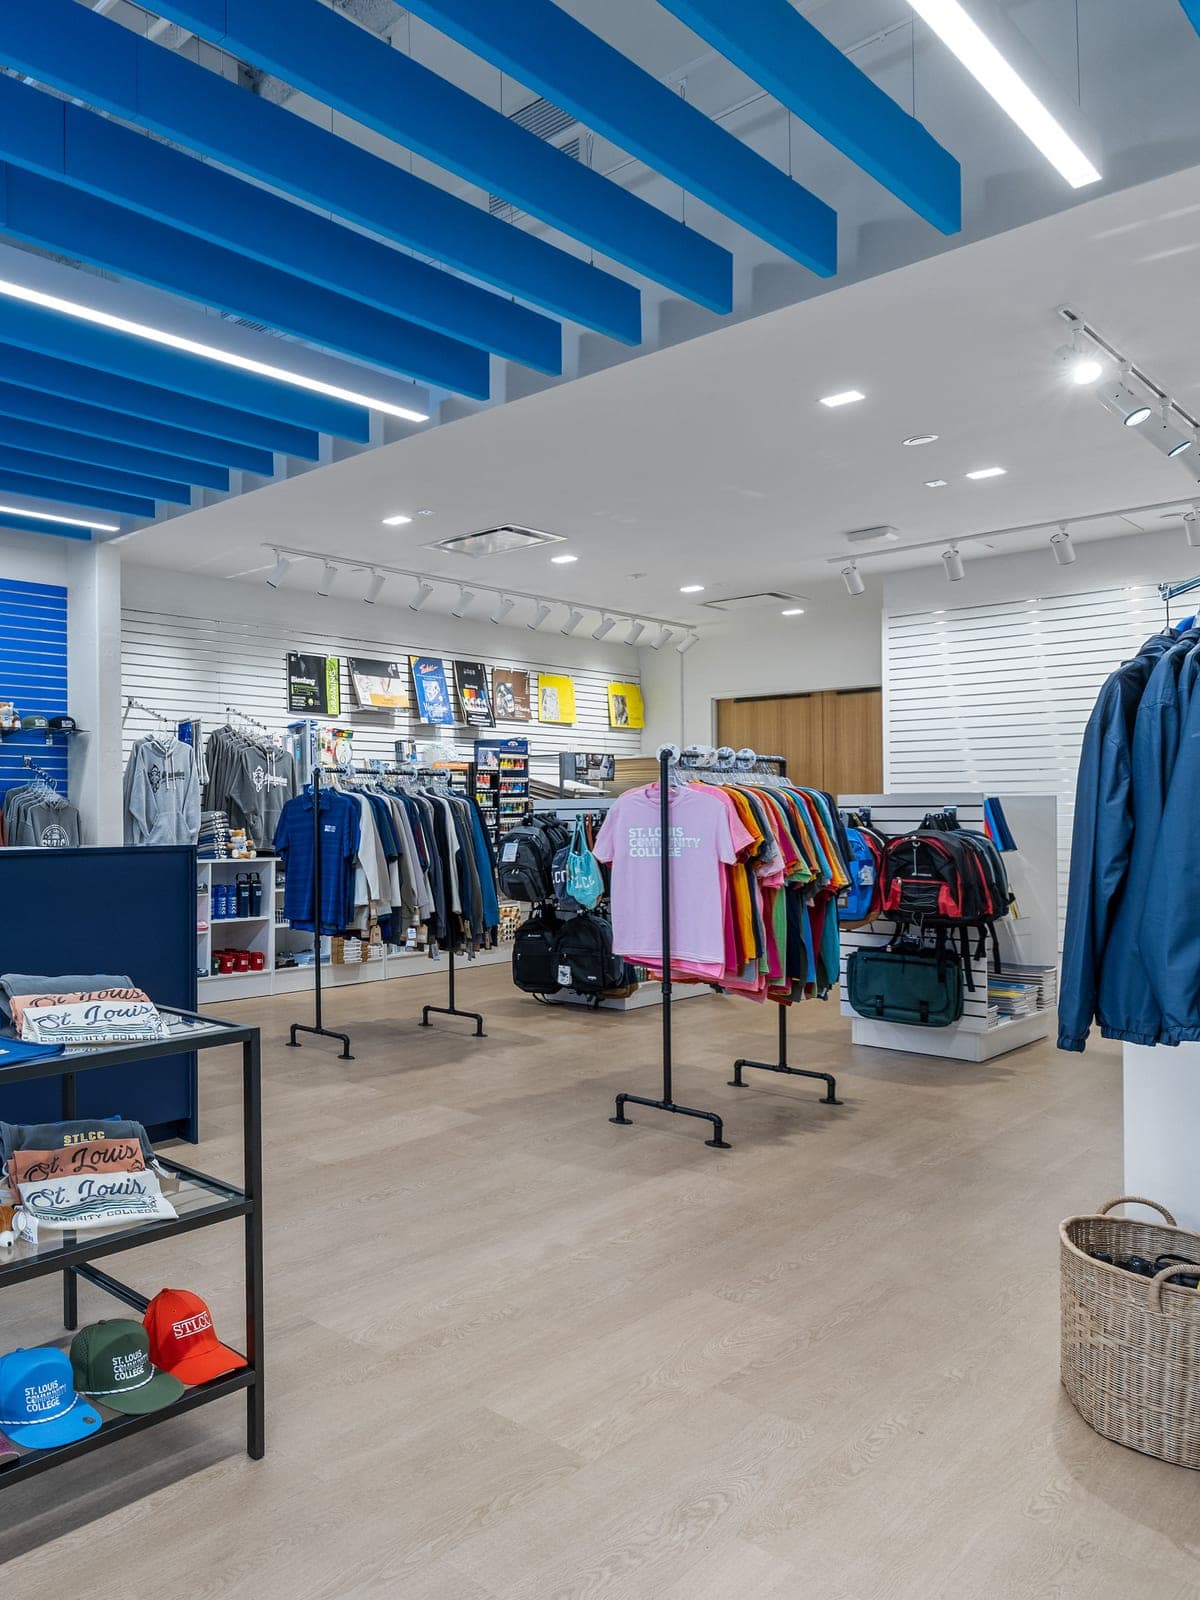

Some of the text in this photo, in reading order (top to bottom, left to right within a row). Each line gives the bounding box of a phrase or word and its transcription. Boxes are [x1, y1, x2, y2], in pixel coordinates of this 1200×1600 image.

[628, 827, 645, 838] ST.
[33, 1004, 154, 1029] St. Louis
[40, 1033, 164, 1042] COMMUNITY COLLEGE
[63, 1131, 105, 1144] STLCC
[23, 1144, 139, 1183] St. Louis
[26, 1178, 147, 1209] St. Louis
[172, 1313, 212, 1338] STLCC
[112, 1349, 143, 1366] ST. LOUIS
[114, 1366, 145, 1381] COLLEGE
[24, 1379, 59, 1397] ST. LOUIS
[26, 1397, 61, 1413] COLLEGE
